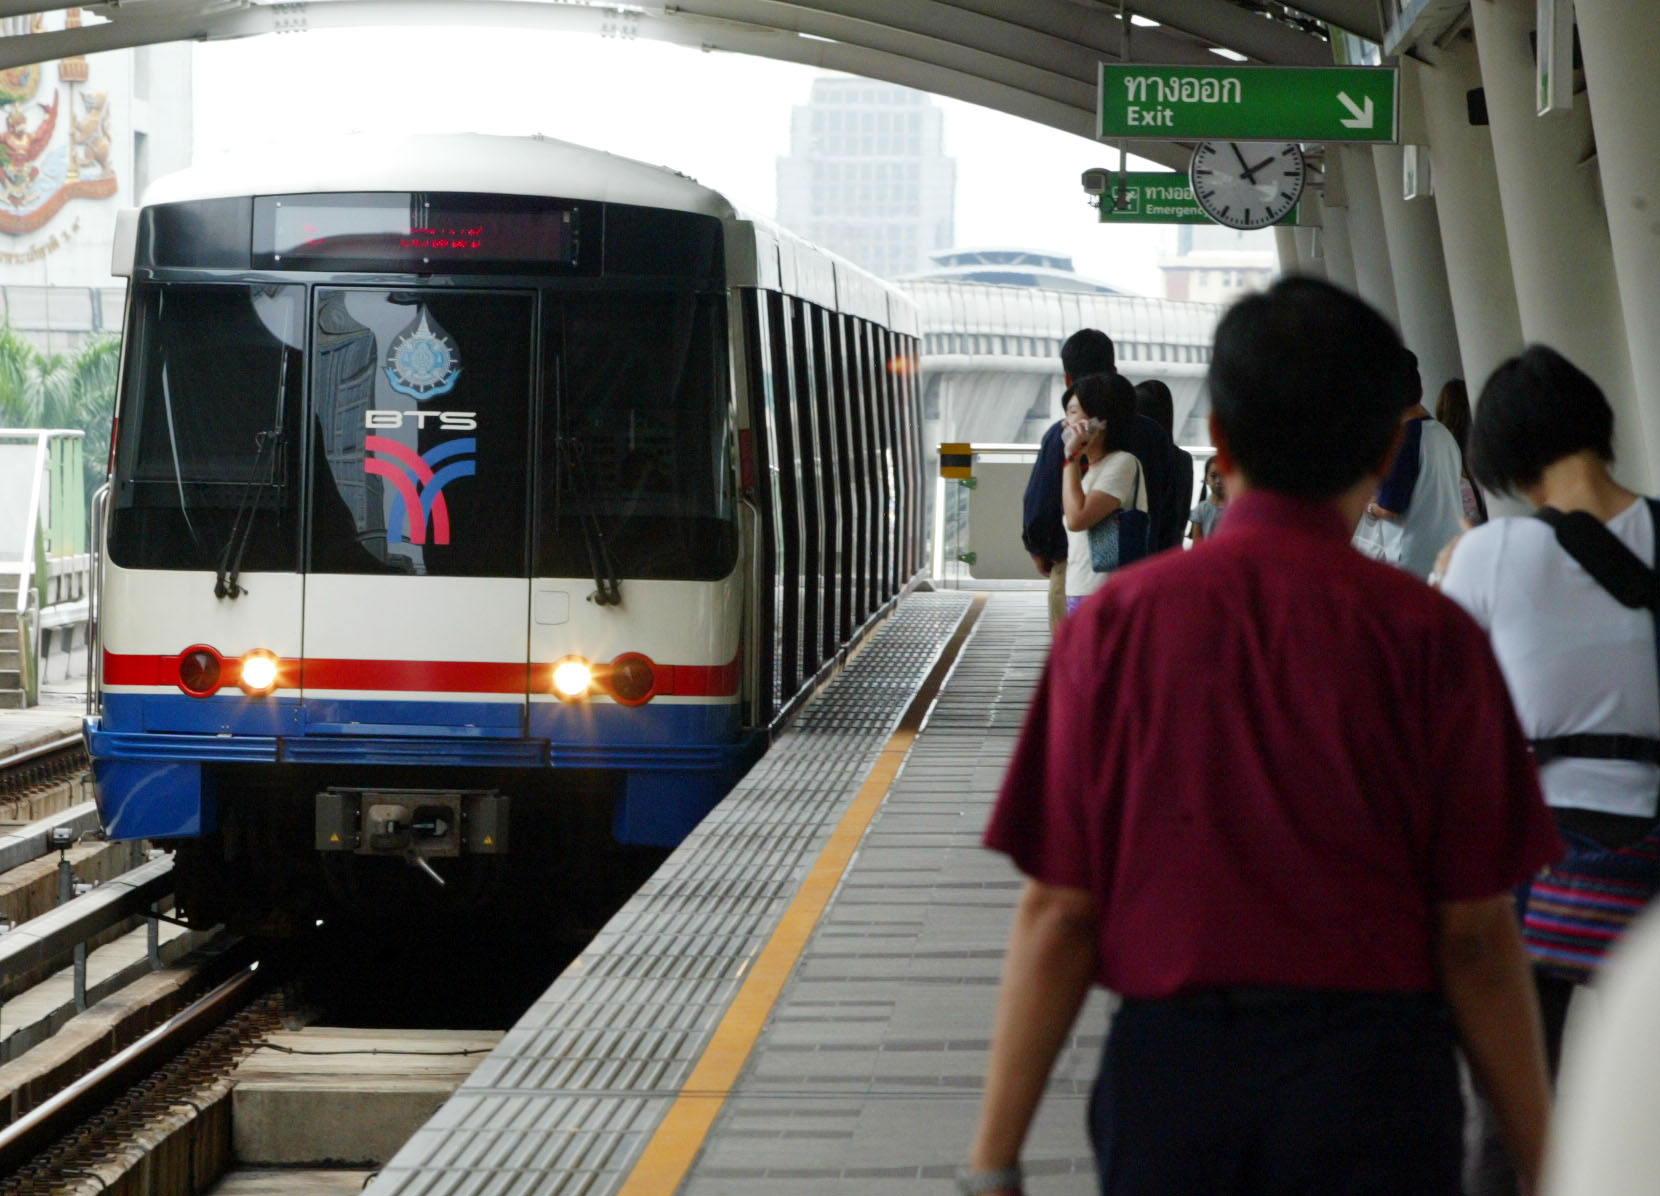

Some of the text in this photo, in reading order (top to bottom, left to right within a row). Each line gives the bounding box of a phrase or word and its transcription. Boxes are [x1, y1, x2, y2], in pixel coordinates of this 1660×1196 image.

[1123, 76, 1241, 103] ทางออก
[1127, 106, 1174, 126] Exit
[1145, 186, 1194, 200] ทางออ
[1146, 204, 1208, 218] Emergenc
[365, 410, 477, 430] BTS
